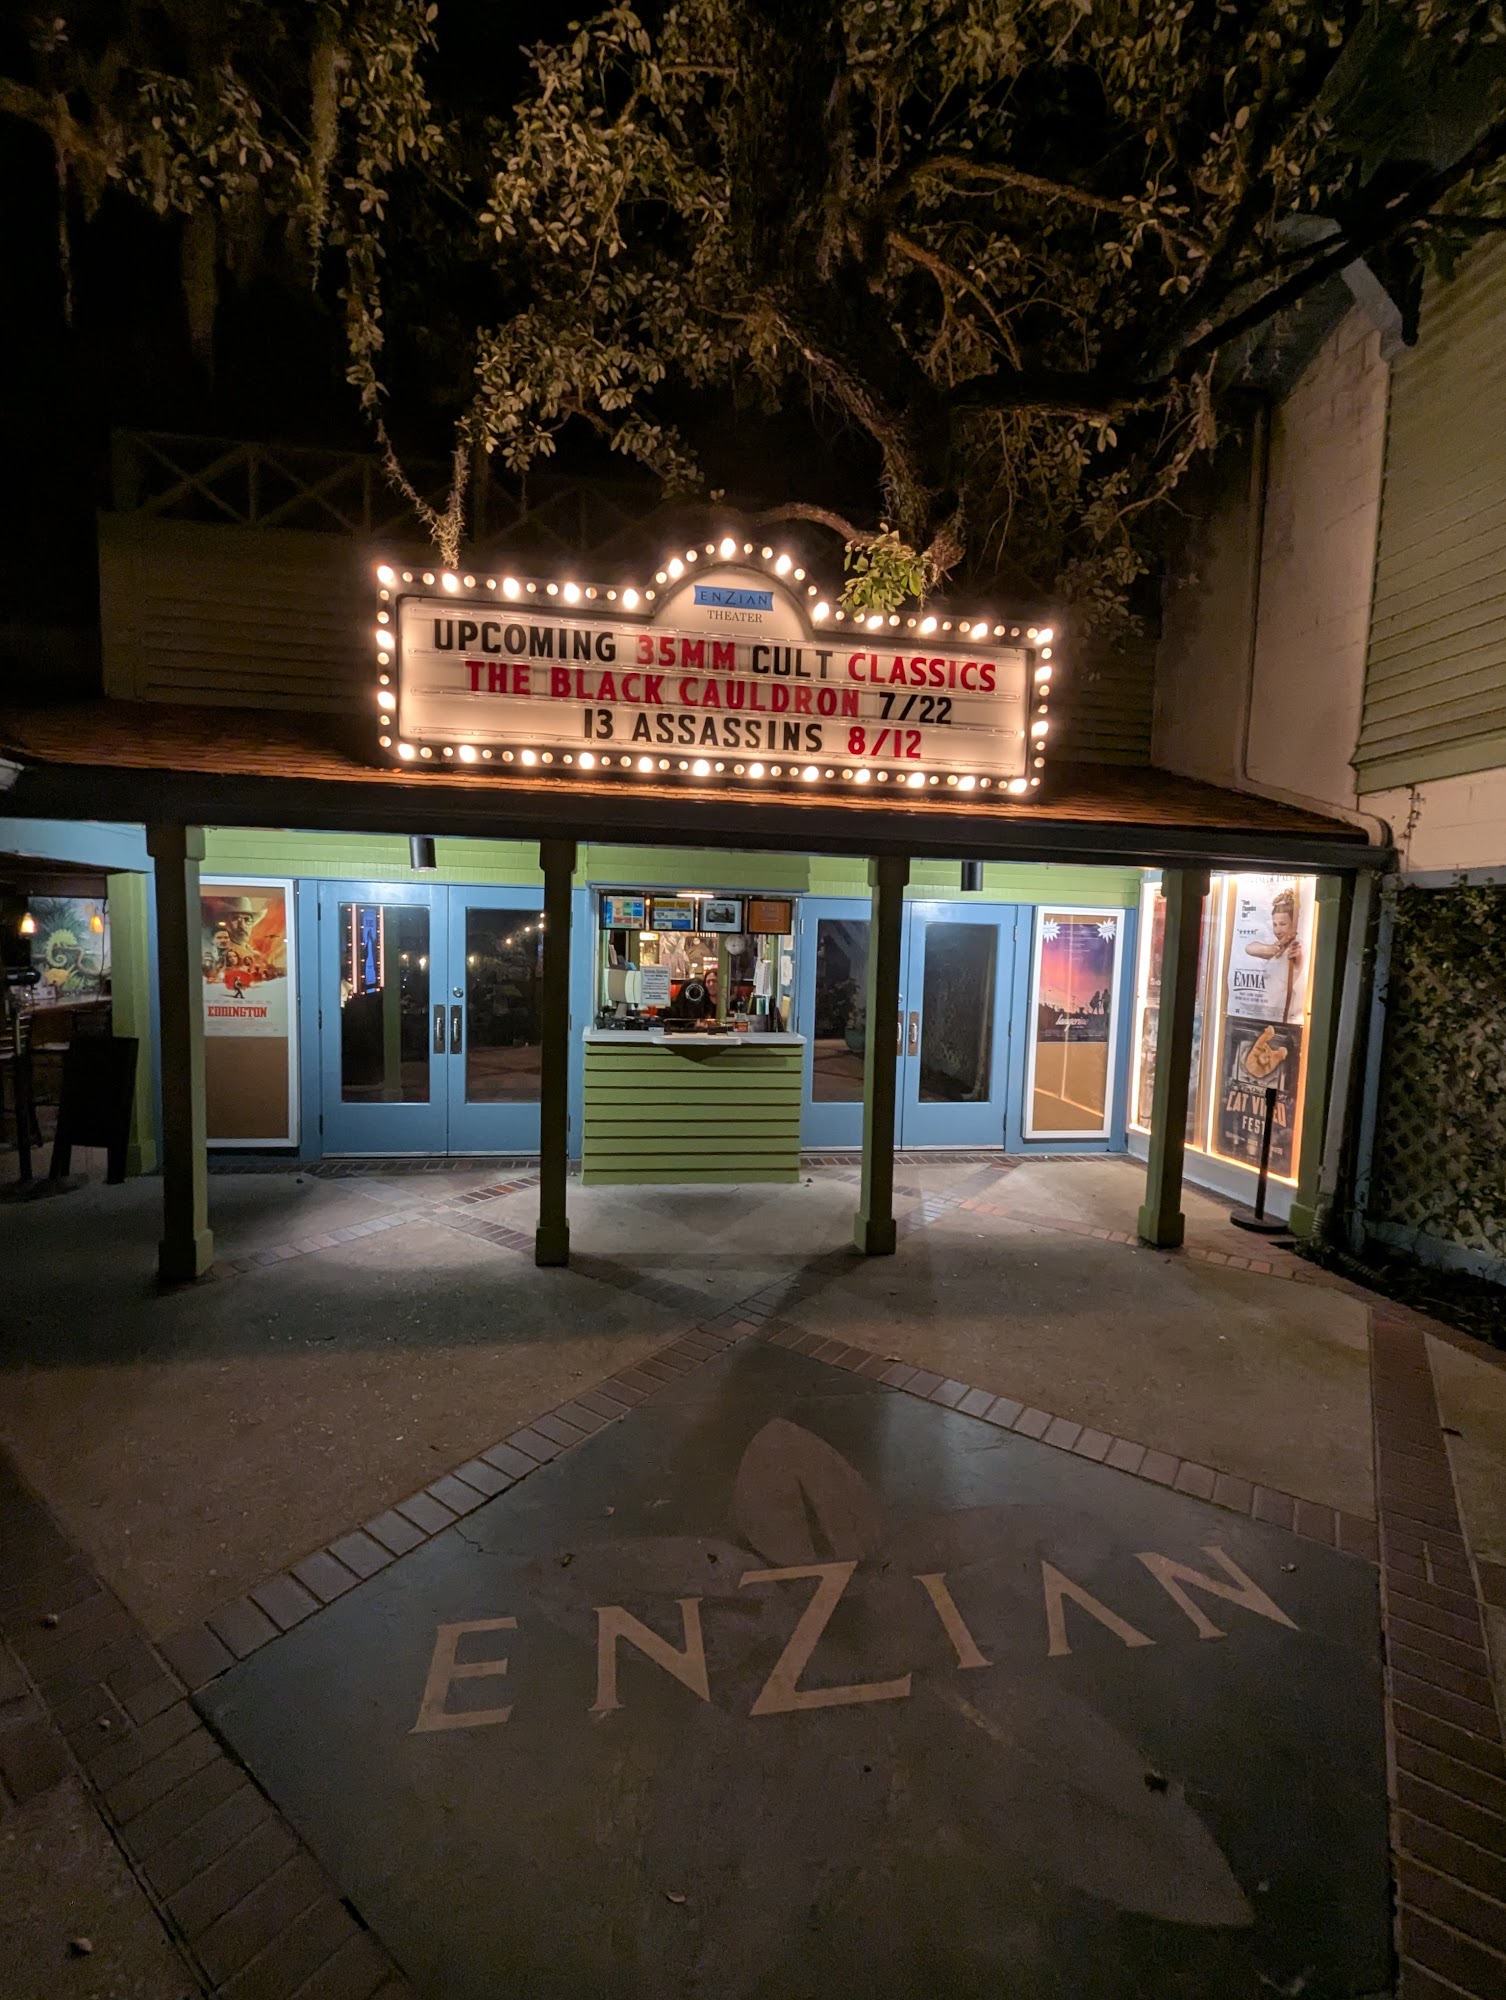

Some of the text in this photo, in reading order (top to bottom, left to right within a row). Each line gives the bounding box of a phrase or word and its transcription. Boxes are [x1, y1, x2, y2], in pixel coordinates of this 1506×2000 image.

[700, 590, 768, 606] ENZIAN
[707, 609, 763, 623] THEATER
[434, 618, 996, 692] UPCOMING 35MM CULT CLASSICS
[465, 660, 952, 725] THE BLACK CAULDRON 7/22
[584, 708, 922, 759] 13 ASSASSINS 8/12
[1233, 970, 1266, 989] EMMA
[1226, 1090, 1249, 1112] CAT
[408, 1545, 1302, 1734] ENZIAN
